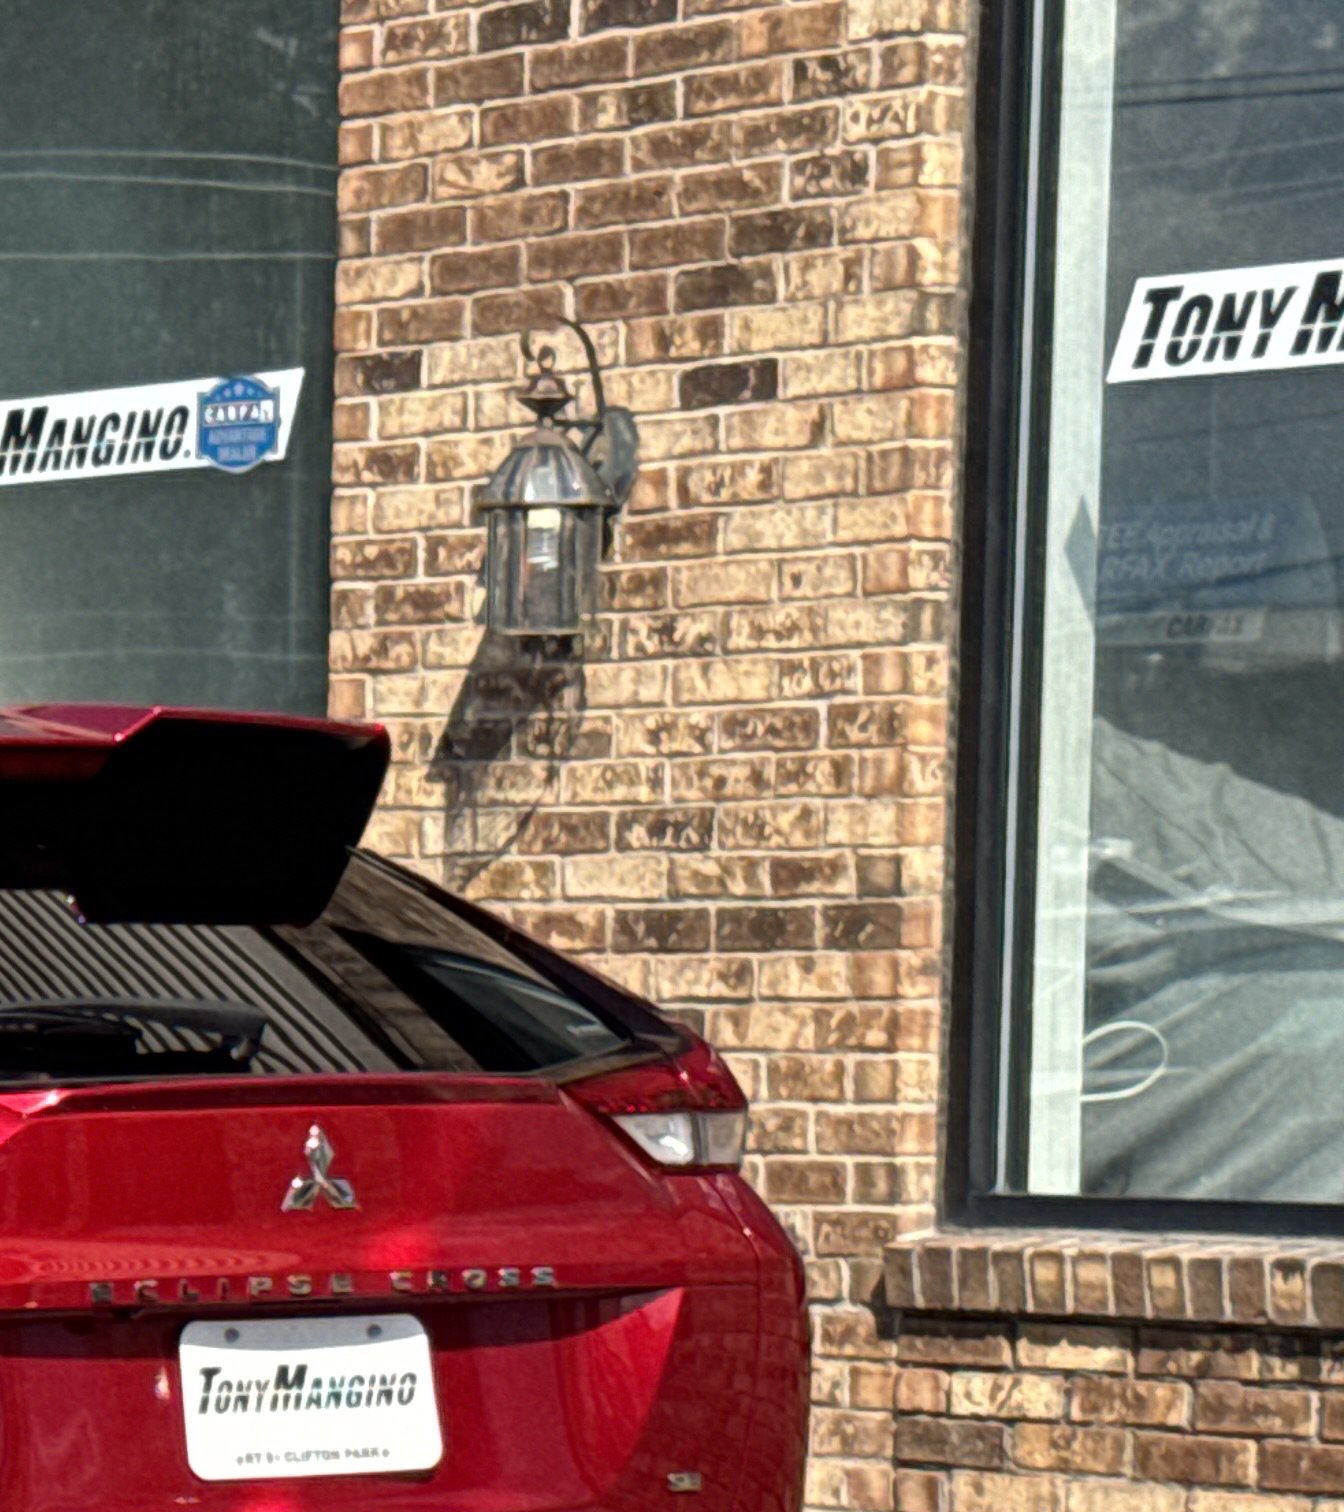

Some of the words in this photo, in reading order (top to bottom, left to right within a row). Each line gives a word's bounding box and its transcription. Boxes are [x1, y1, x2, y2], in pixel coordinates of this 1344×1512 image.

[1132, 285, 1300, 369] TONY
[89, 1273, 354, 1303] ECLIPSE
[389, 1266, 556, 1291] CROSS
